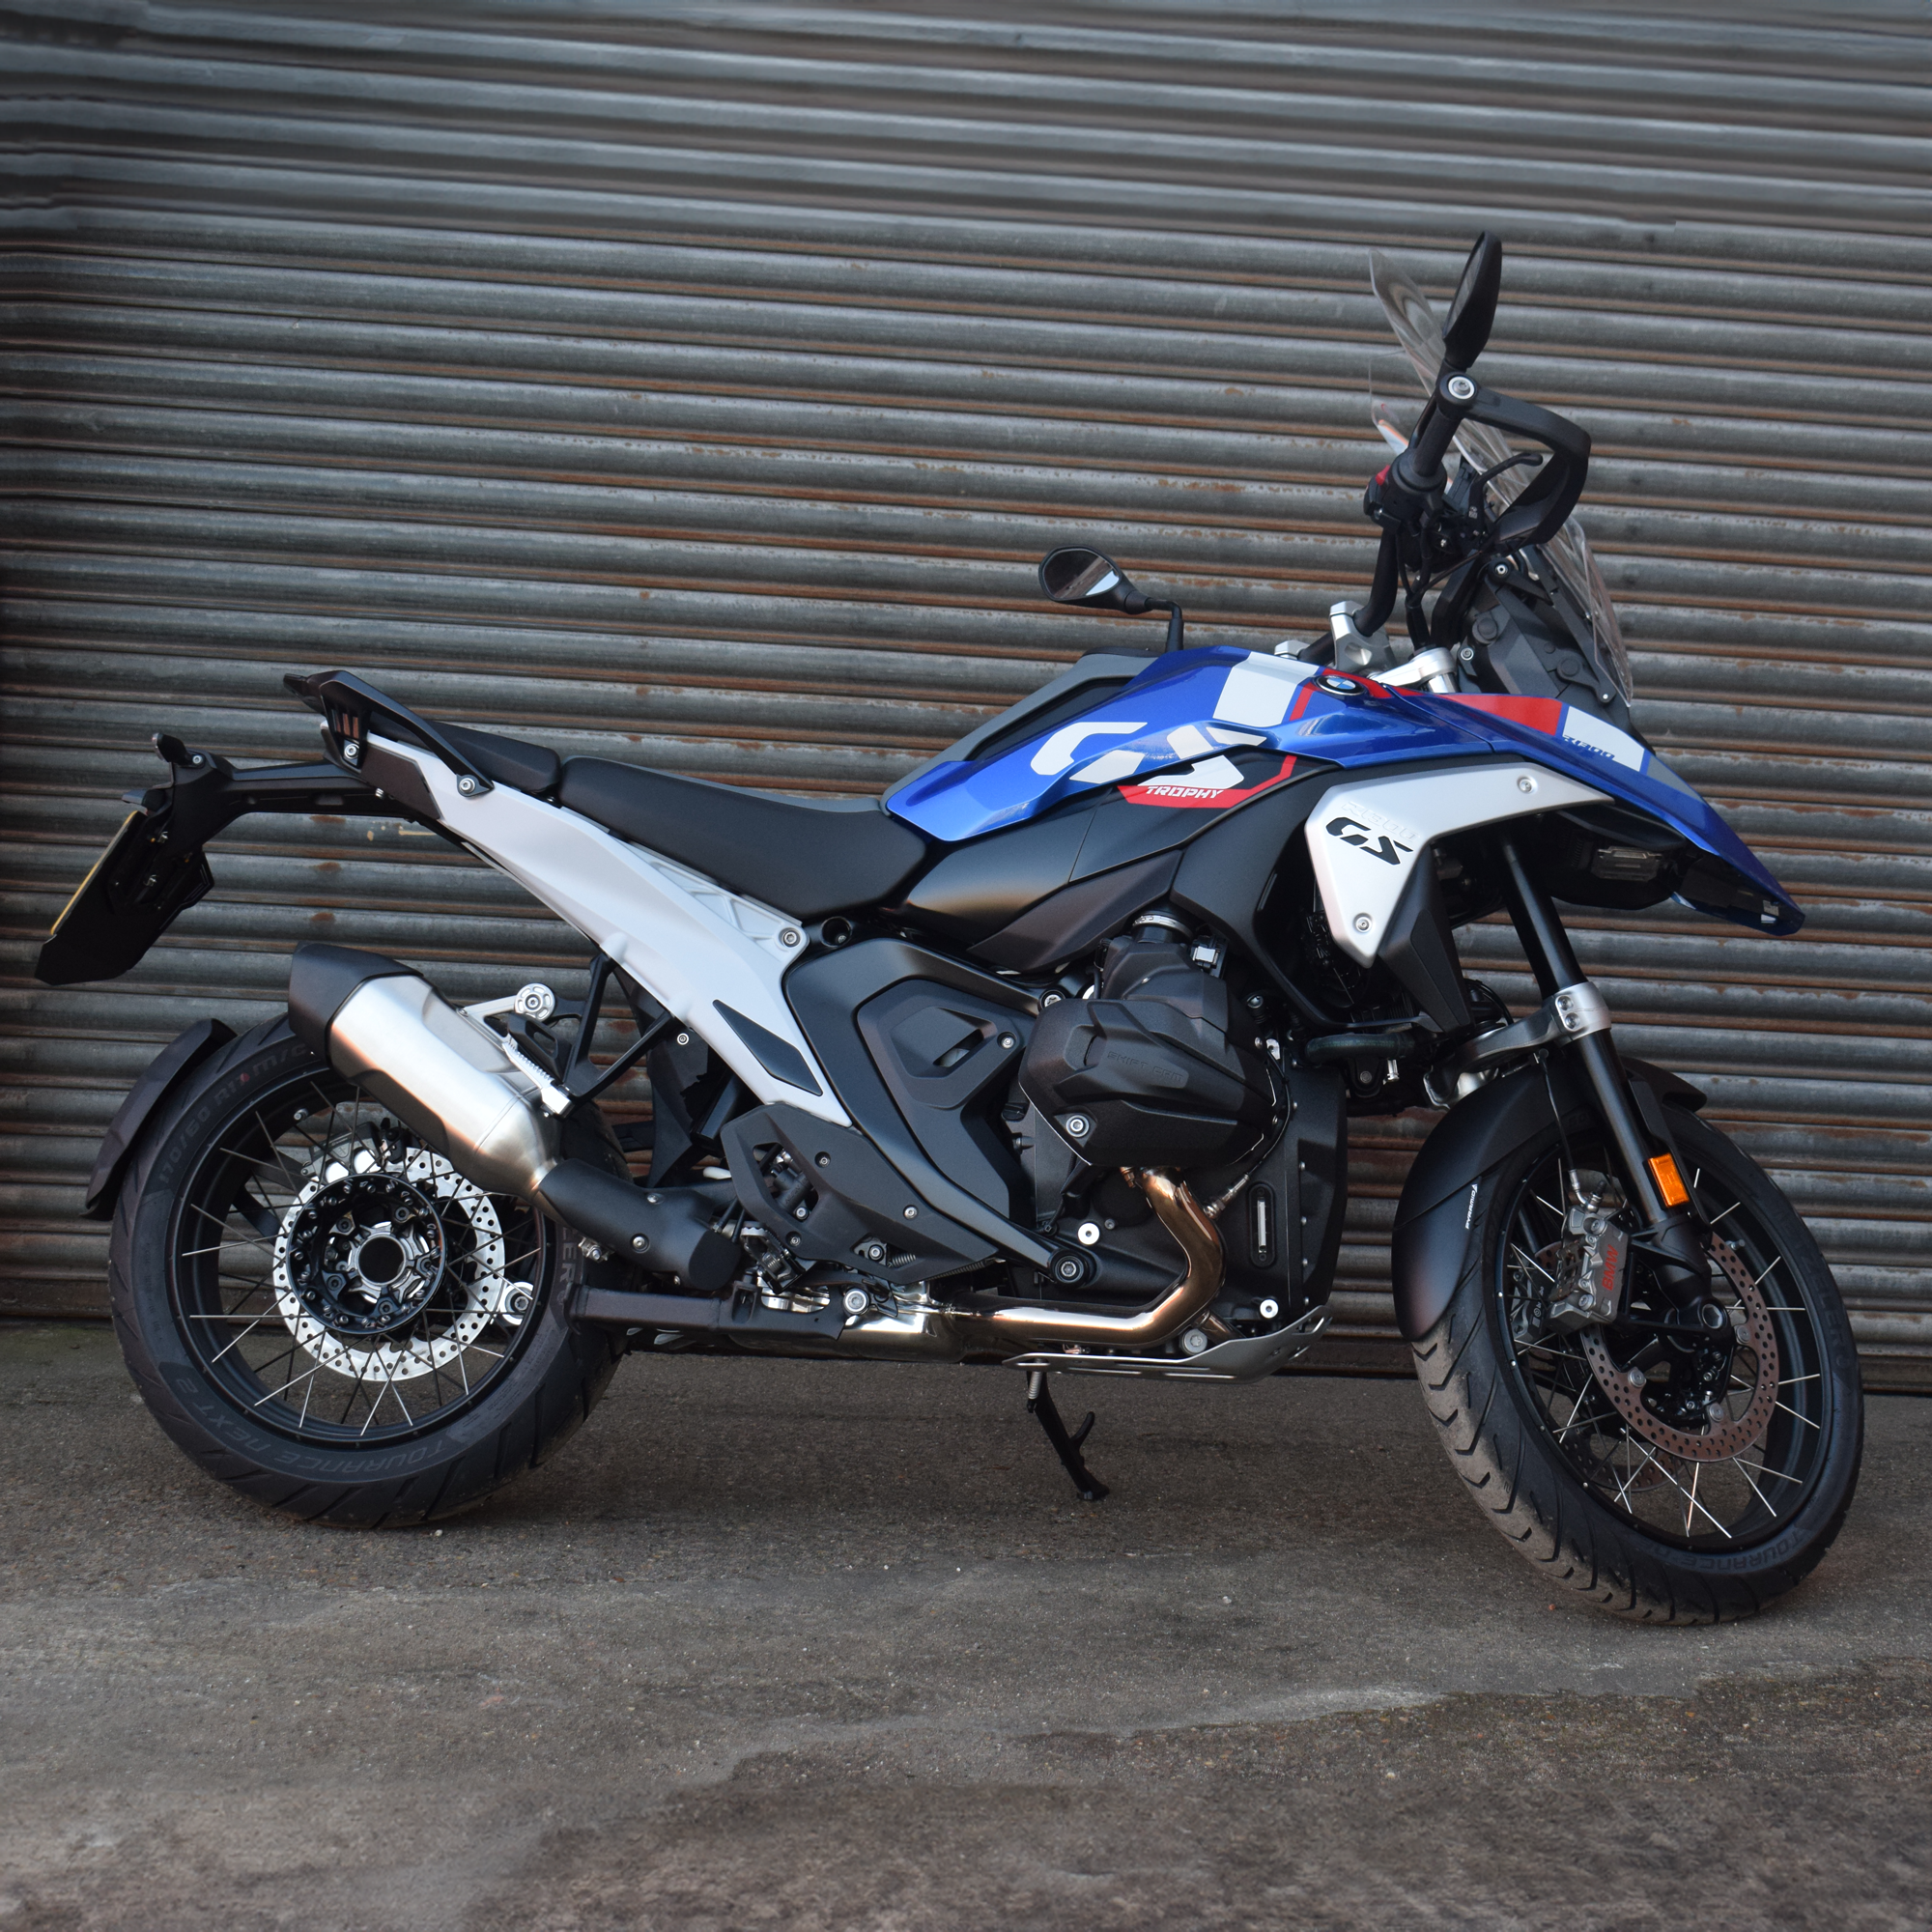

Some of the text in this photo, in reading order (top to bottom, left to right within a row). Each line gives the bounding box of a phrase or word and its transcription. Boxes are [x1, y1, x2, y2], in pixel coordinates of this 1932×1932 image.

[1030, 721, 1267, 790] GS
[1146, 785, 1225, 800] TROPHY
[1325, 816, 1414, 866] GS
[1106, 1050, 1184, 1083] SHIFT CAM
[1464, 1189, 1476, 1230] PYRAMID
[1602, 1243, 1619, 1292] BMW
